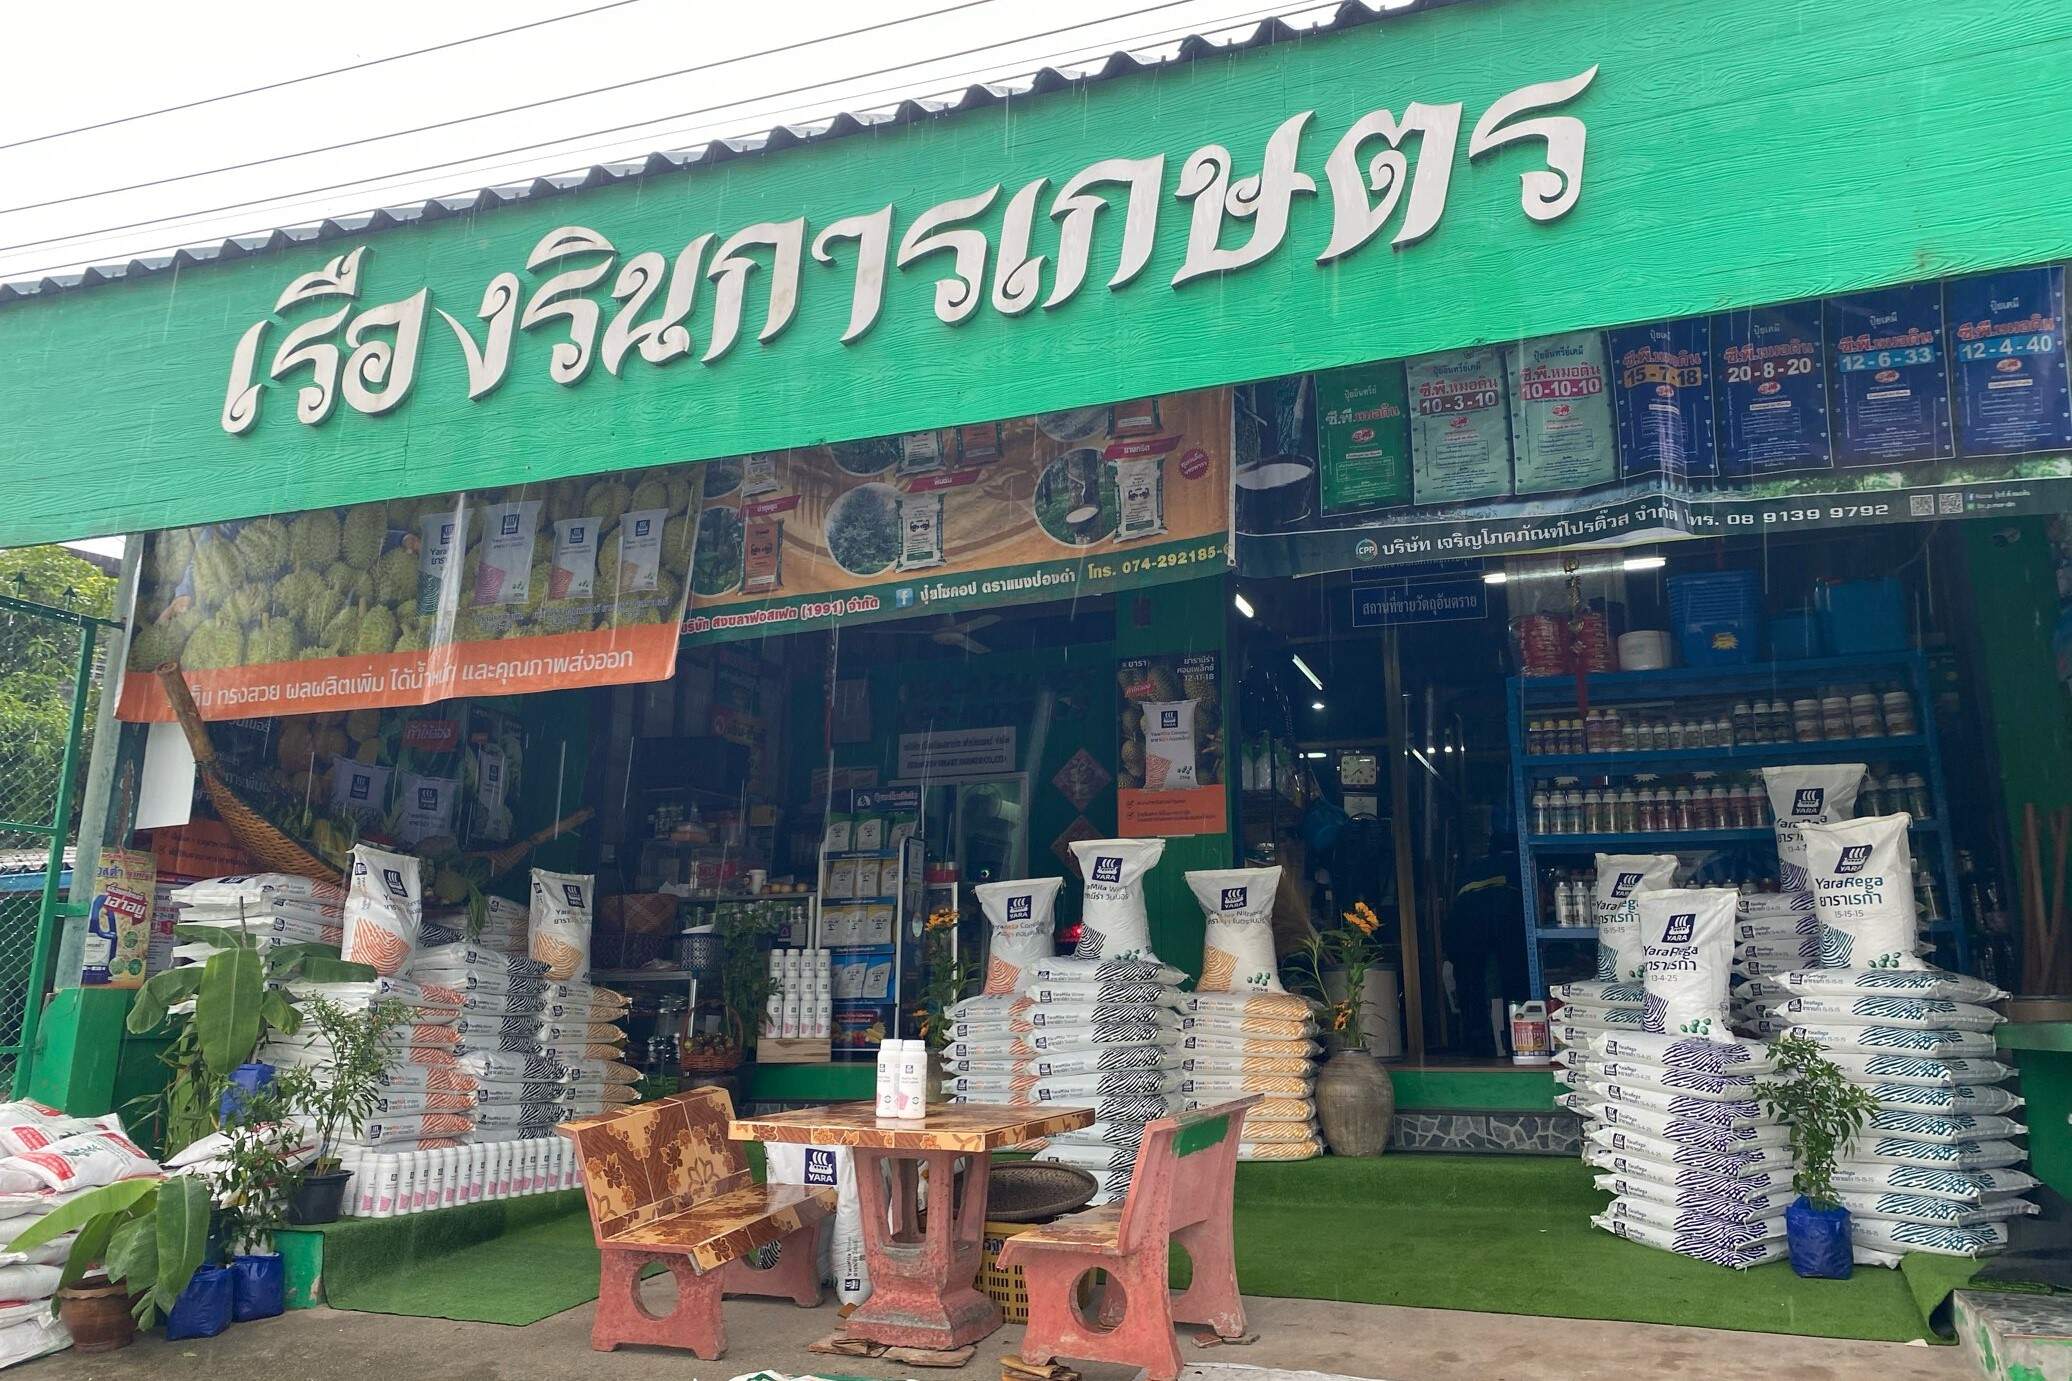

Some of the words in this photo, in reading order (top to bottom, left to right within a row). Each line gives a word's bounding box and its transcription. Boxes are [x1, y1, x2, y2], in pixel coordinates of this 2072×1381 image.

[221, 64, 1599, 435] เรืองรินการเกษตร
[1383, 535, 1431, 556] บริษัท
[1727, 514, 1754, 525] 08
[1763, 511, 1820, 523] 9139
[1830, 504, 1889, 518] 9792
[1087, 562, 1117, 580] โทร.
[800, 599, 844, 621] (1991)
[217, 683, 280, 706] ทรงสวย
[286, 665, 385, 700] ผลผลิตเพิ่ม
[462, 648, 633, 686] และคุณภาพส่งออก
[1815, 876, 1884, 891] YaraRega
[1224, 901, 1245, 909] YARA
[1834, 909, 1865, 918] 15-15-15
[1651, 974, 1678, 982] 13-4-25
[808, 1173, 834, 1184] YARA
